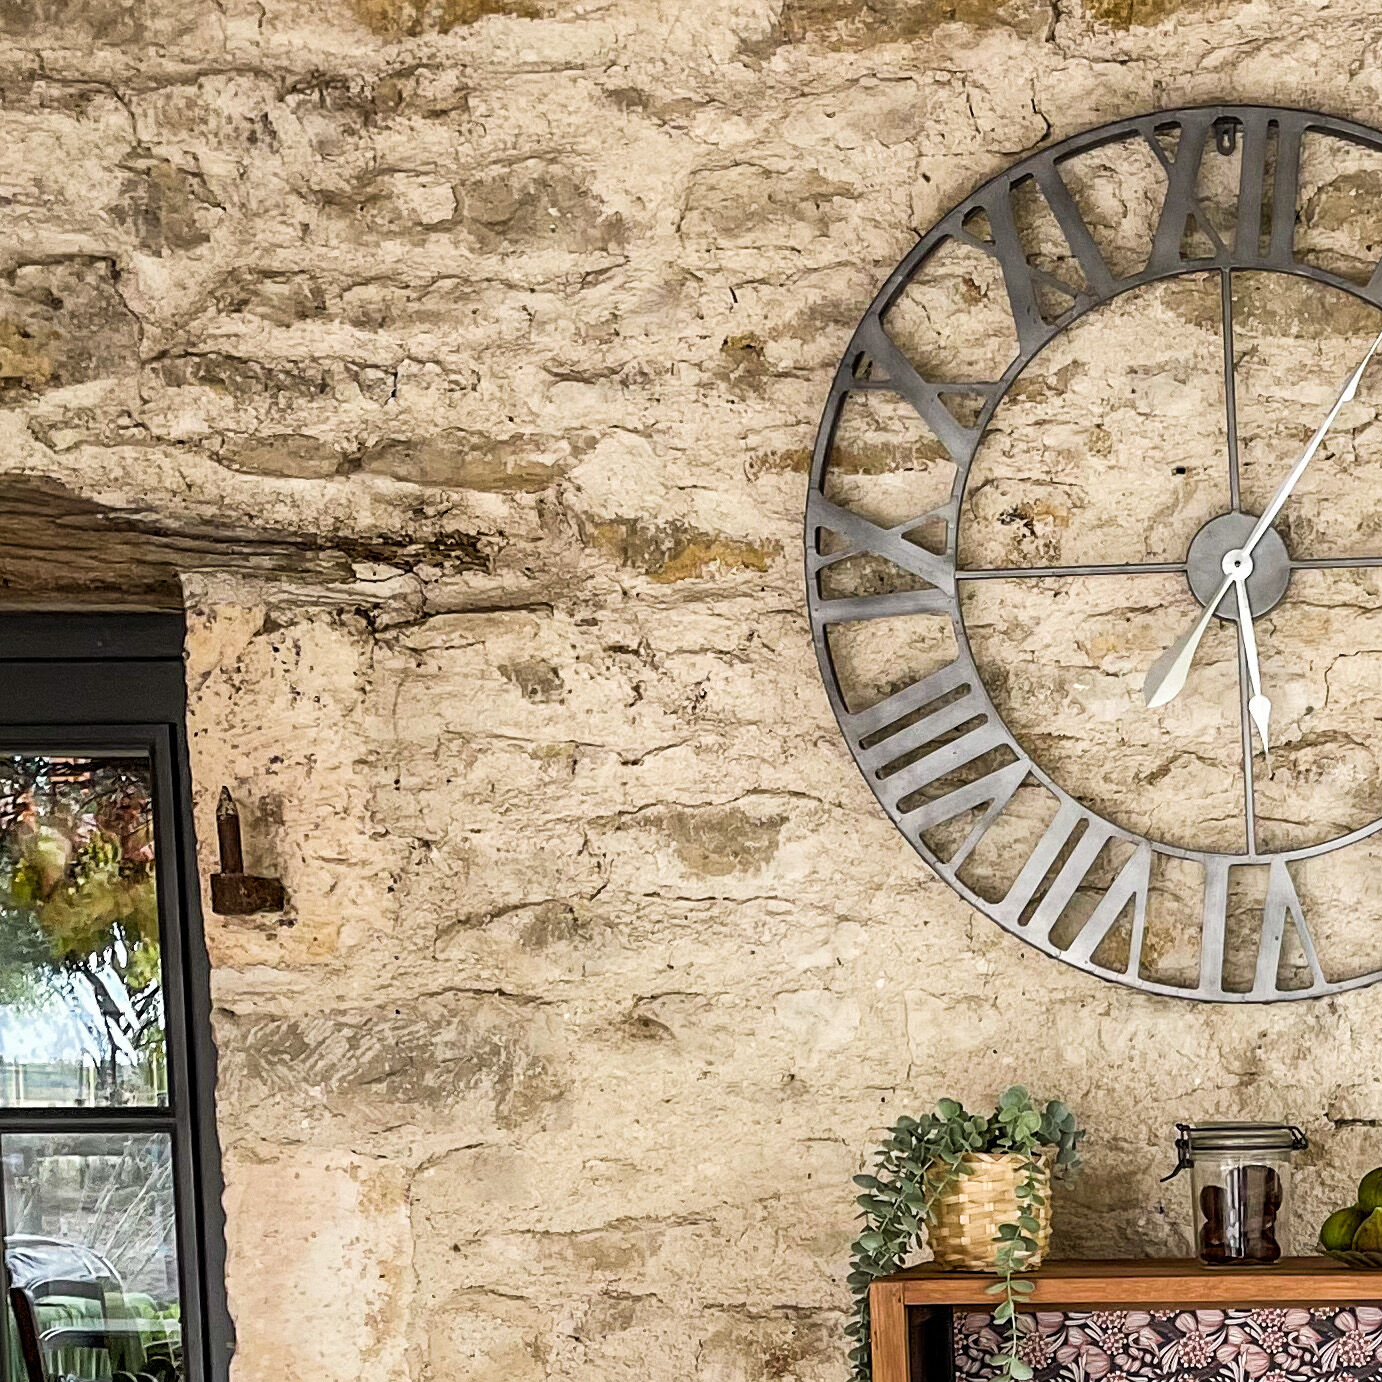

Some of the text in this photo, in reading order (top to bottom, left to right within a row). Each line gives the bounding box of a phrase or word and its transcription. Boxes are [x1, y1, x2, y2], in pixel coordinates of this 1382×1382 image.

[953, 161, 1121, 355] XI
[1138, 113, 1309, 270] XII
[842, 322, 1008, 464] X
[1000, 803, 1154, 981] VII
